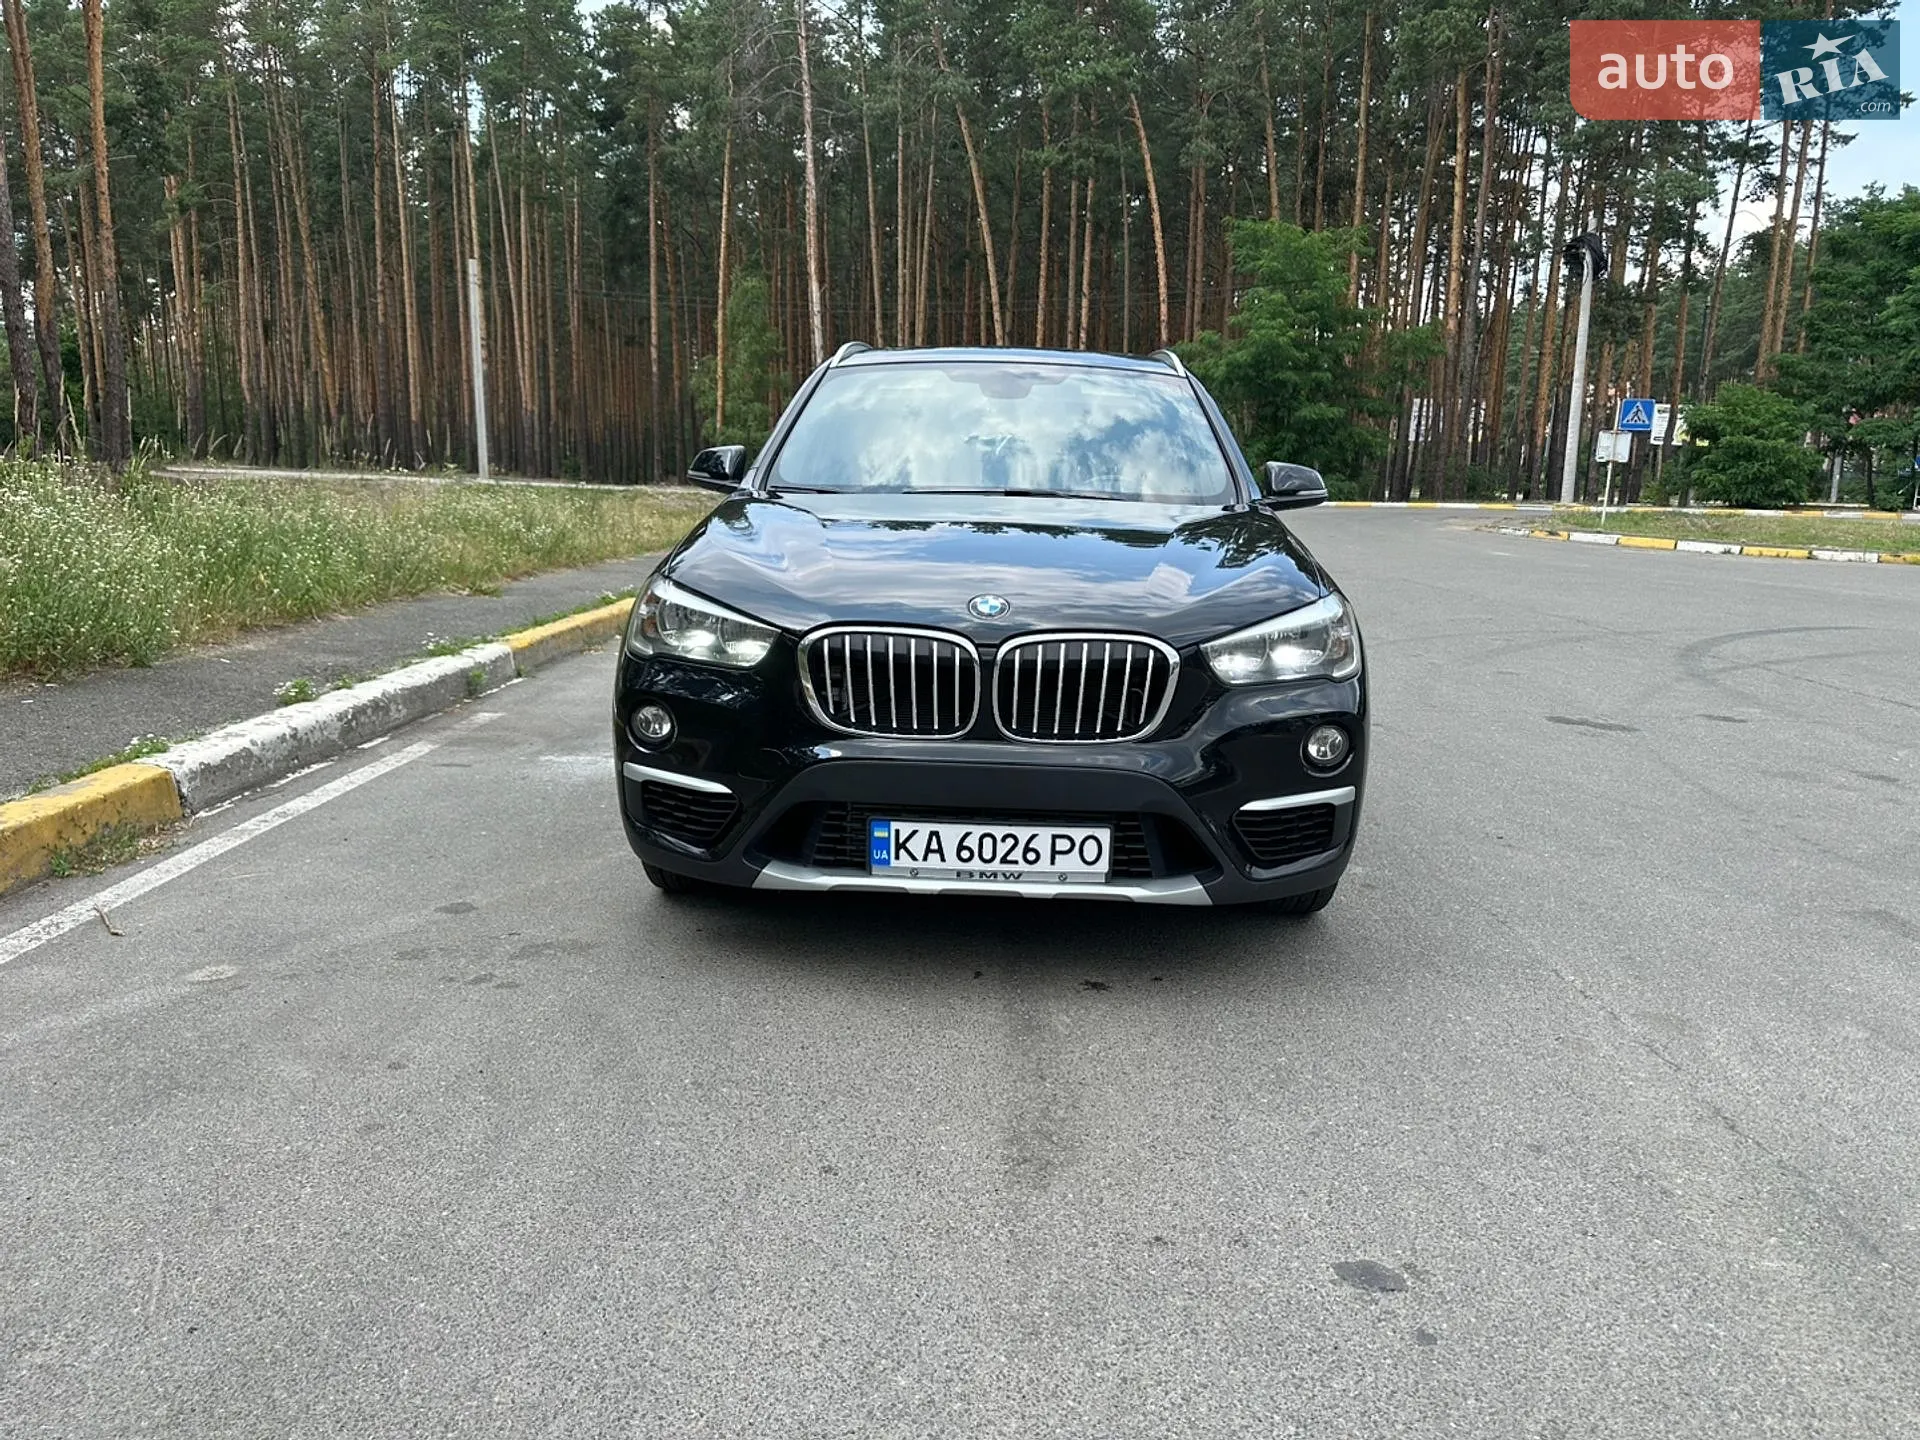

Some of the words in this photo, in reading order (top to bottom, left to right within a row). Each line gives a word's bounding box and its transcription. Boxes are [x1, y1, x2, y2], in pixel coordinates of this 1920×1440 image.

[894, 828, 946, 863] KA
[956, 832, 1041, 865] 6026
[1050, 834, 1103, 866] PO
[873, 849, 889, 860] UA
[956, 871, 1023, 880] BMW
